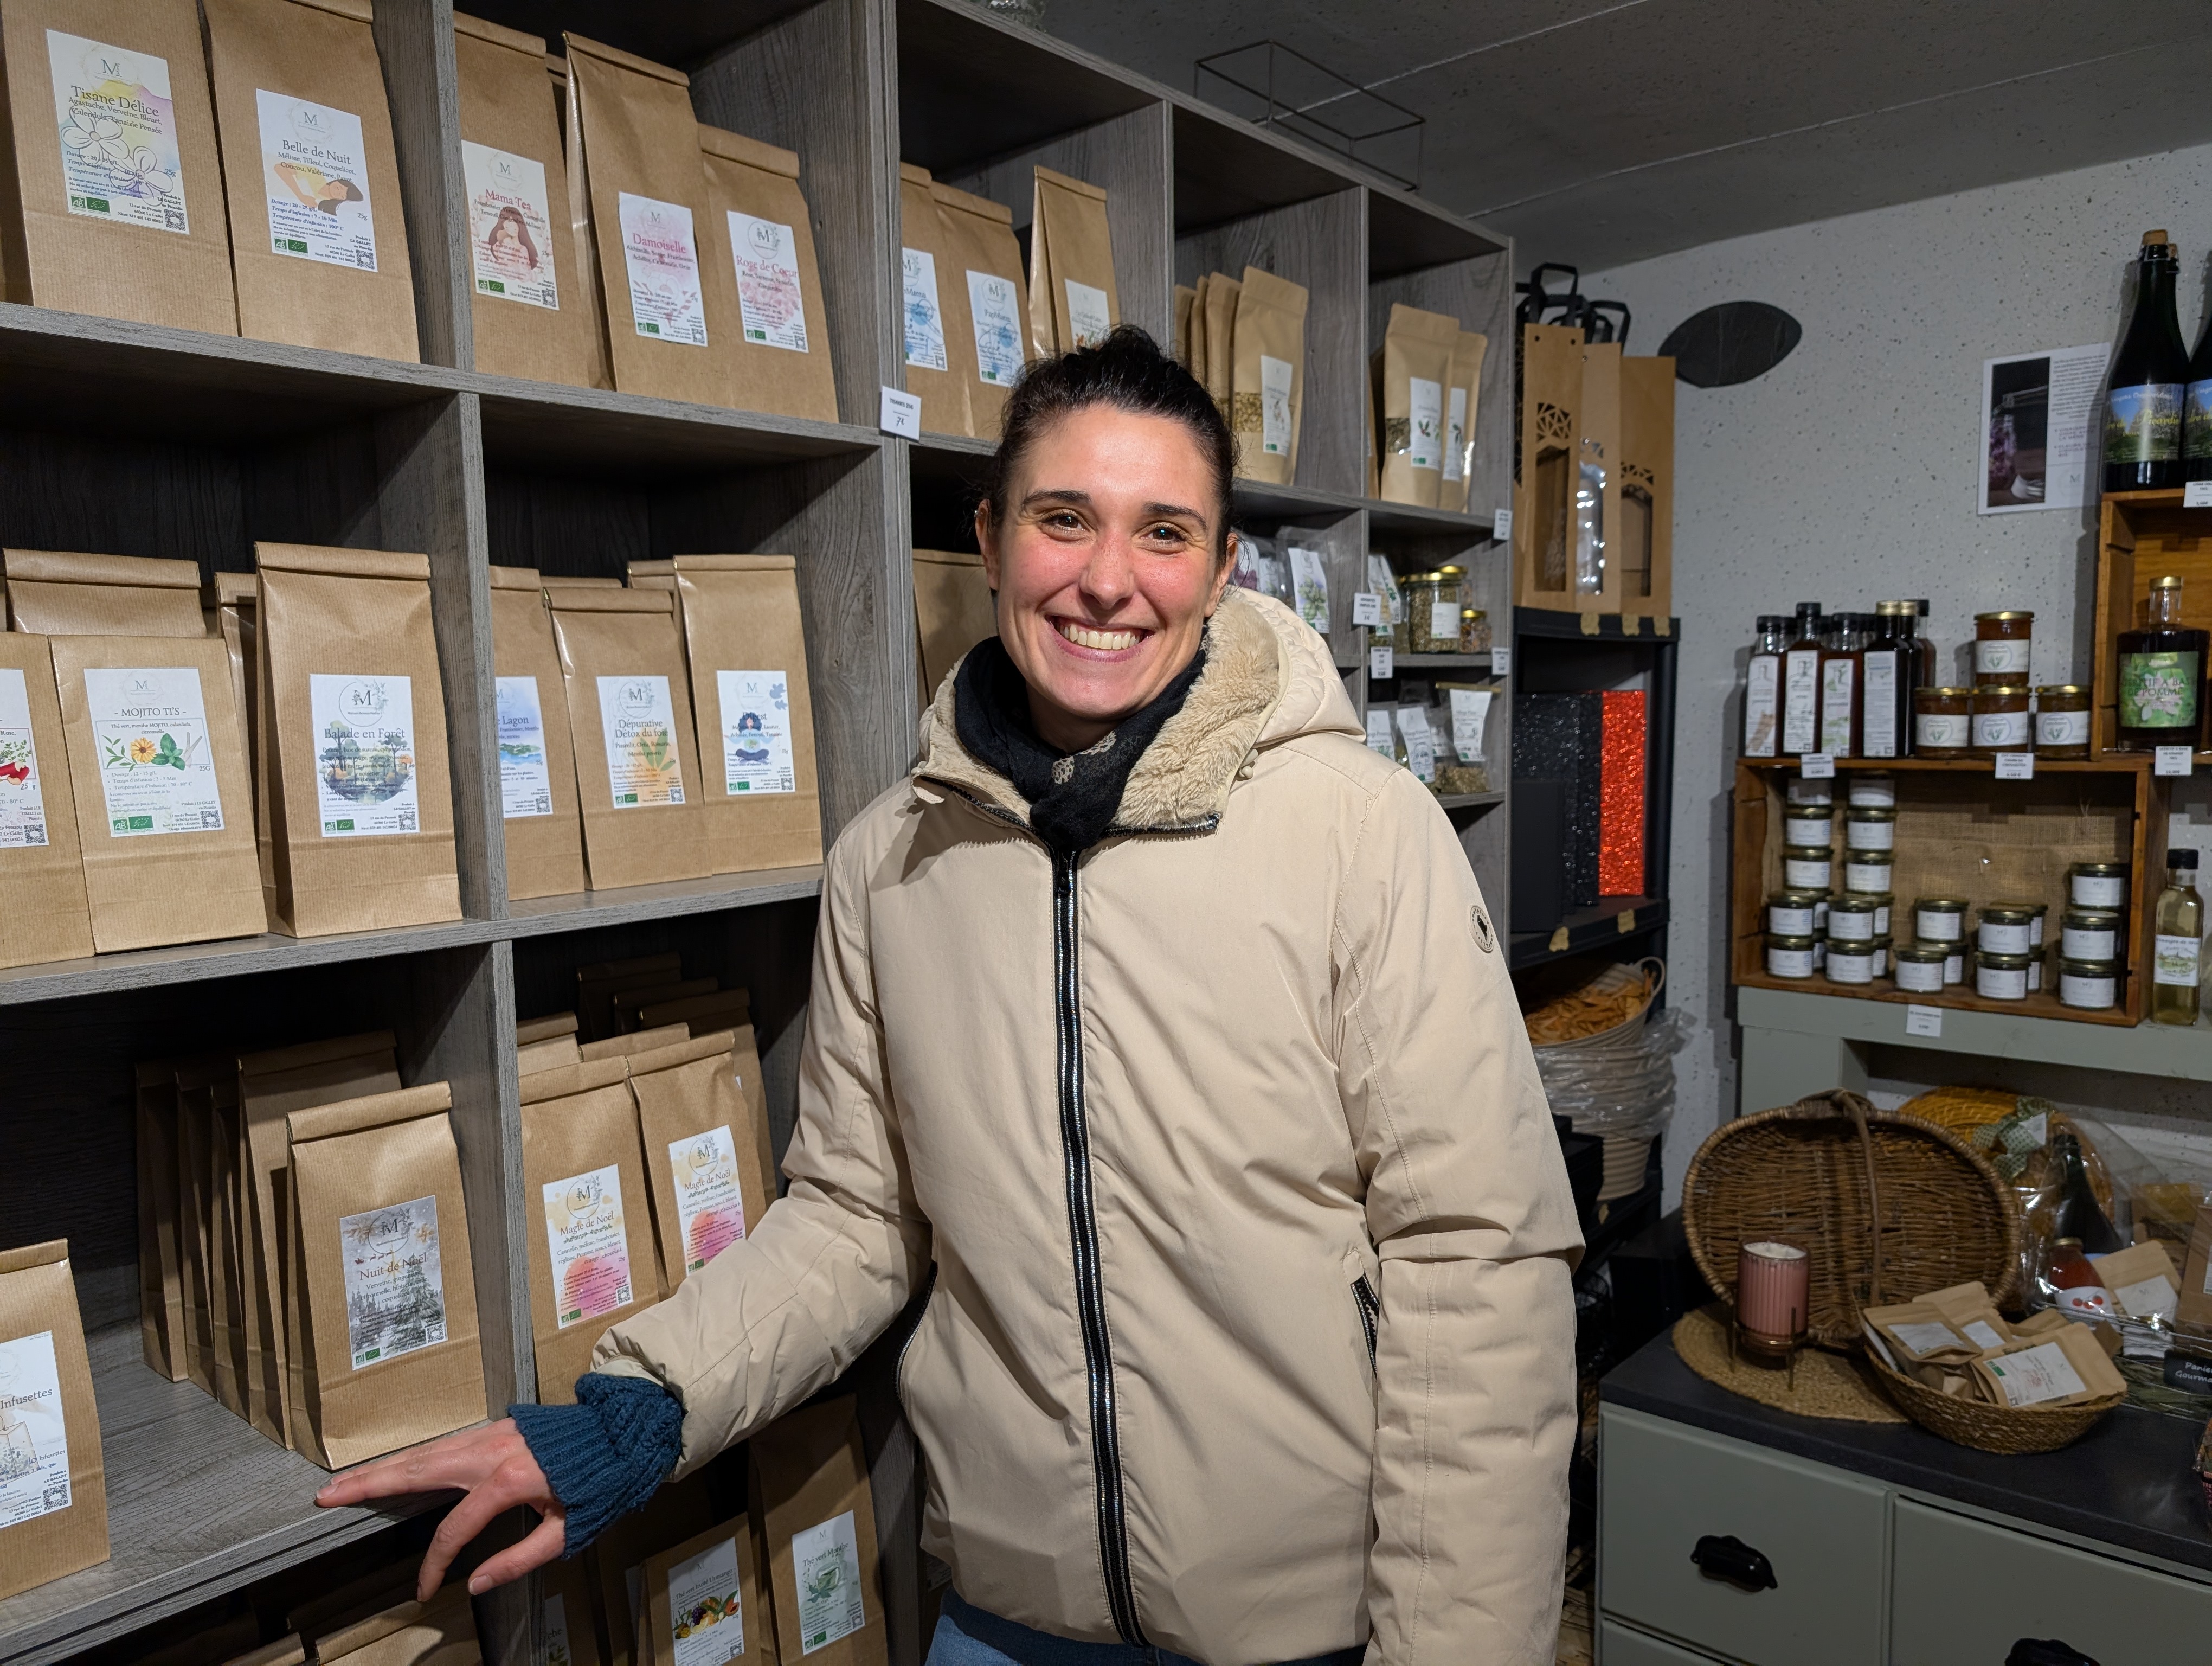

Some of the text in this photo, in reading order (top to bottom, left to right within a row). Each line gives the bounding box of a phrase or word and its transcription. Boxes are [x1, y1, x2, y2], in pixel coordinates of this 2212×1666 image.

[71, 86, 159, 117] Tisane Délice
[69, 97, 163, 125] Agastache, Verveine, Bleuet,
[72, 108, 162, 134] Calendula, Tanaisie Pensée
[304, 112, 318, 126] M
[67, 151, 87, 159] Dosage
[282, 140, 351, 164] Belle de Nuit
[68, 158, 85, 167] Temps
[278, 152, 356, 176] Mélisse, Tilleul, Coquelicot,
[500, 162, 511, 175] M
[68, 166, 102, 177] Température
[165, 168, 176, 178] 25g
[280, 162, 306, 172] Coucou,
[307, 167, 336, 180] Valériane,
[271, 198, 288, 207] Dosage
[486, 189, 531, 210] Mama Tea
[273, 213, 301, 223] Température
[358, 213, 368, 221] 25g
[651, 212, 660, 223] M
[757, 228, 770, 242] M
[633, 233, 686, 254] Damoiselle
[736, 255, 798, 278] Rose de Coeur
[136, 680, 149, 690] M
[747, 682, 757, 693] M
[354, 690, 372, 705] M
[629, 688, 642, 701] M
[121, 707, 180, 718] MOJITO TI'S
[502, 716, 529, 727] Lagon
[619, 719, 663, 730] Dépurative
[324, 728, 359, 739] Balade
[378, 728, 406, 738] Forêt
[615, 728, 668, 738] Détox du foie
[697, 1144, 710, 1159] M
[685, 1168, 731, 1191] Magie de Noël
[577, 1185, 590, 1201] M
[382, 1219, 398, 1235] M
[561, 1210, 614, 1236] Magie de Noël
[557, 1246, 578, 1255] Cannelle,
[584, 1256, 599, 1264] orange
[360, 1252, 427, 1281] Nuit de Noël
[366, 1279, 392, 1290] Verveine,
[361, 1288, 391, 1300] citronnelle,
[1, 1389, 53, 1409] Infusettes
[39, 1450, 66, 1461] Infusettes
[7, 1471, 29, 1481] infusettes
[803, 1556, 814, 1566] Thé
[815, 1552, 826, 1561] vert
[676, 1591, 685, 1599] Thé
